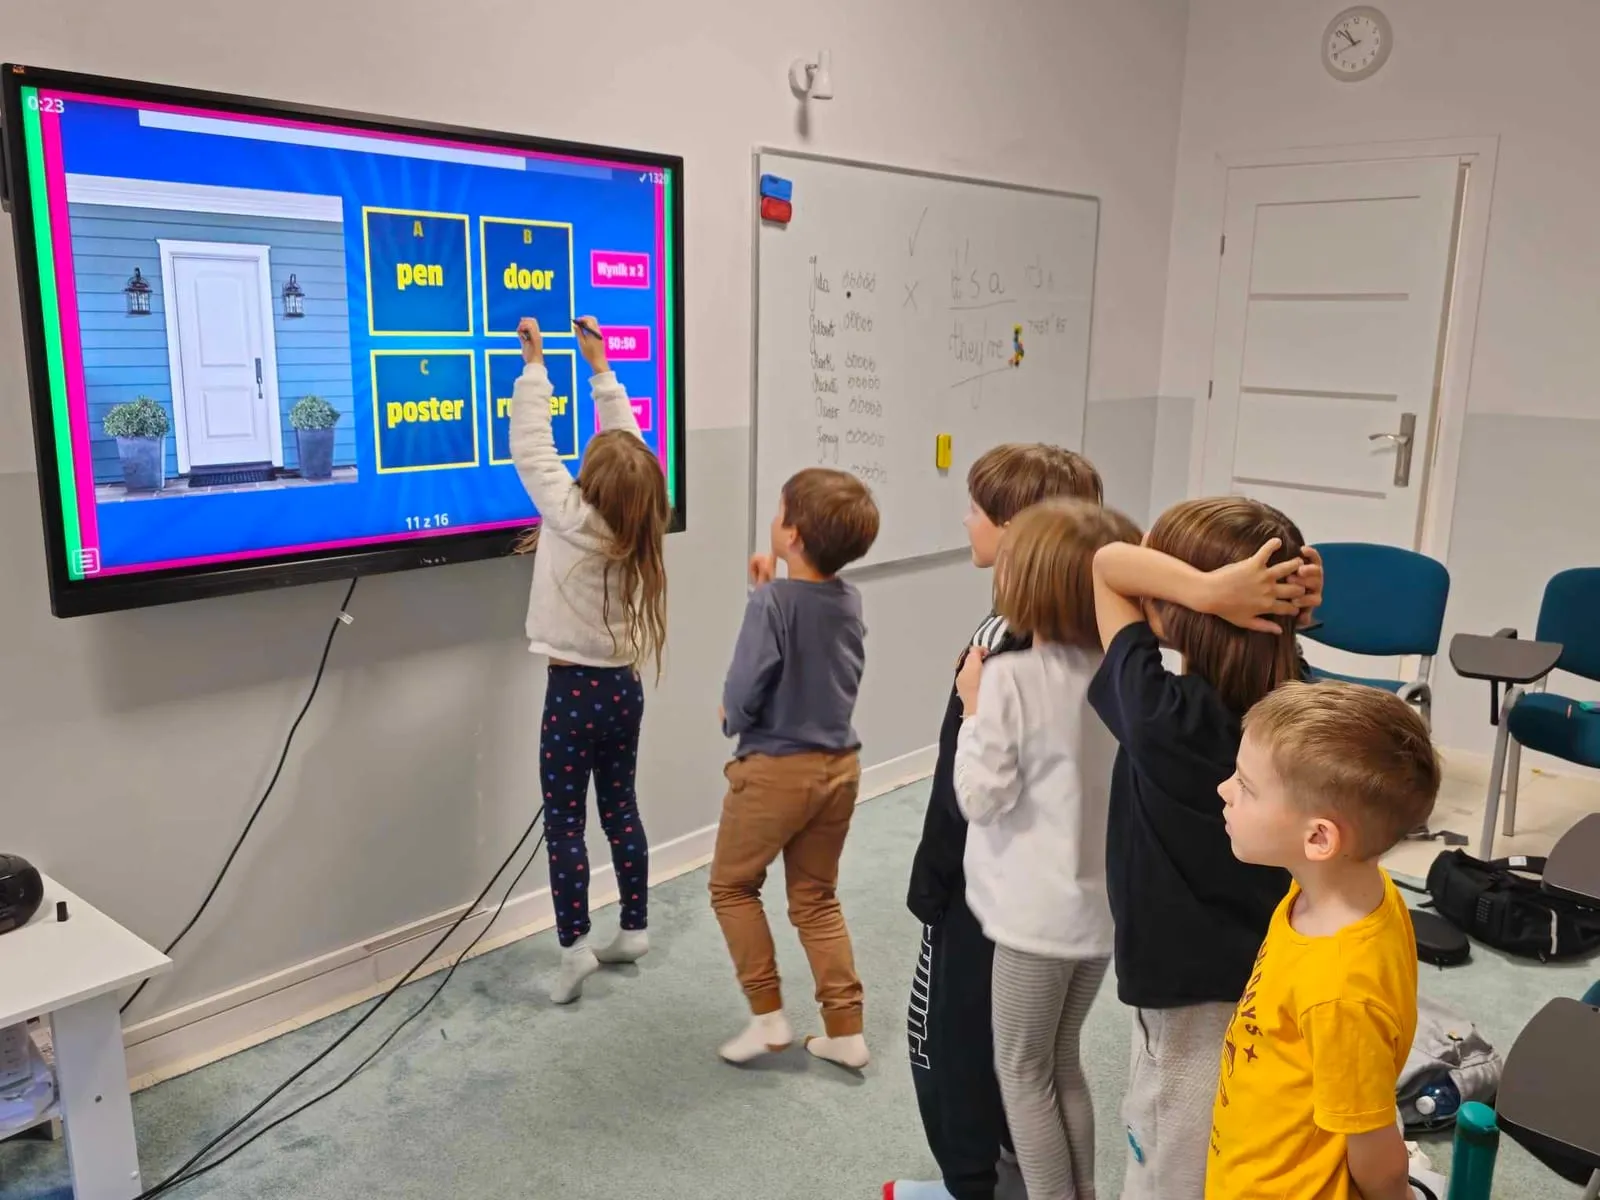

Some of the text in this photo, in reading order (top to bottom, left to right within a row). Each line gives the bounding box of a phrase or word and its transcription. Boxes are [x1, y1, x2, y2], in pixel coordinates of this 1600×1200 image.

[27, 95, 65, 114] 0:23
[412, 220, 424, 237] A
[523, 229, 533, 244] B
[397, 263, 443, 289] pen
[504, 263, 554, 290] door
[637, 264, 644, 278] 2
[608, 336, 637, 350] 50:50
[419, 359, 430, 375] C
[387, 397, 464, 428] poster
[405, 513, 449, 531] 11 z 16
